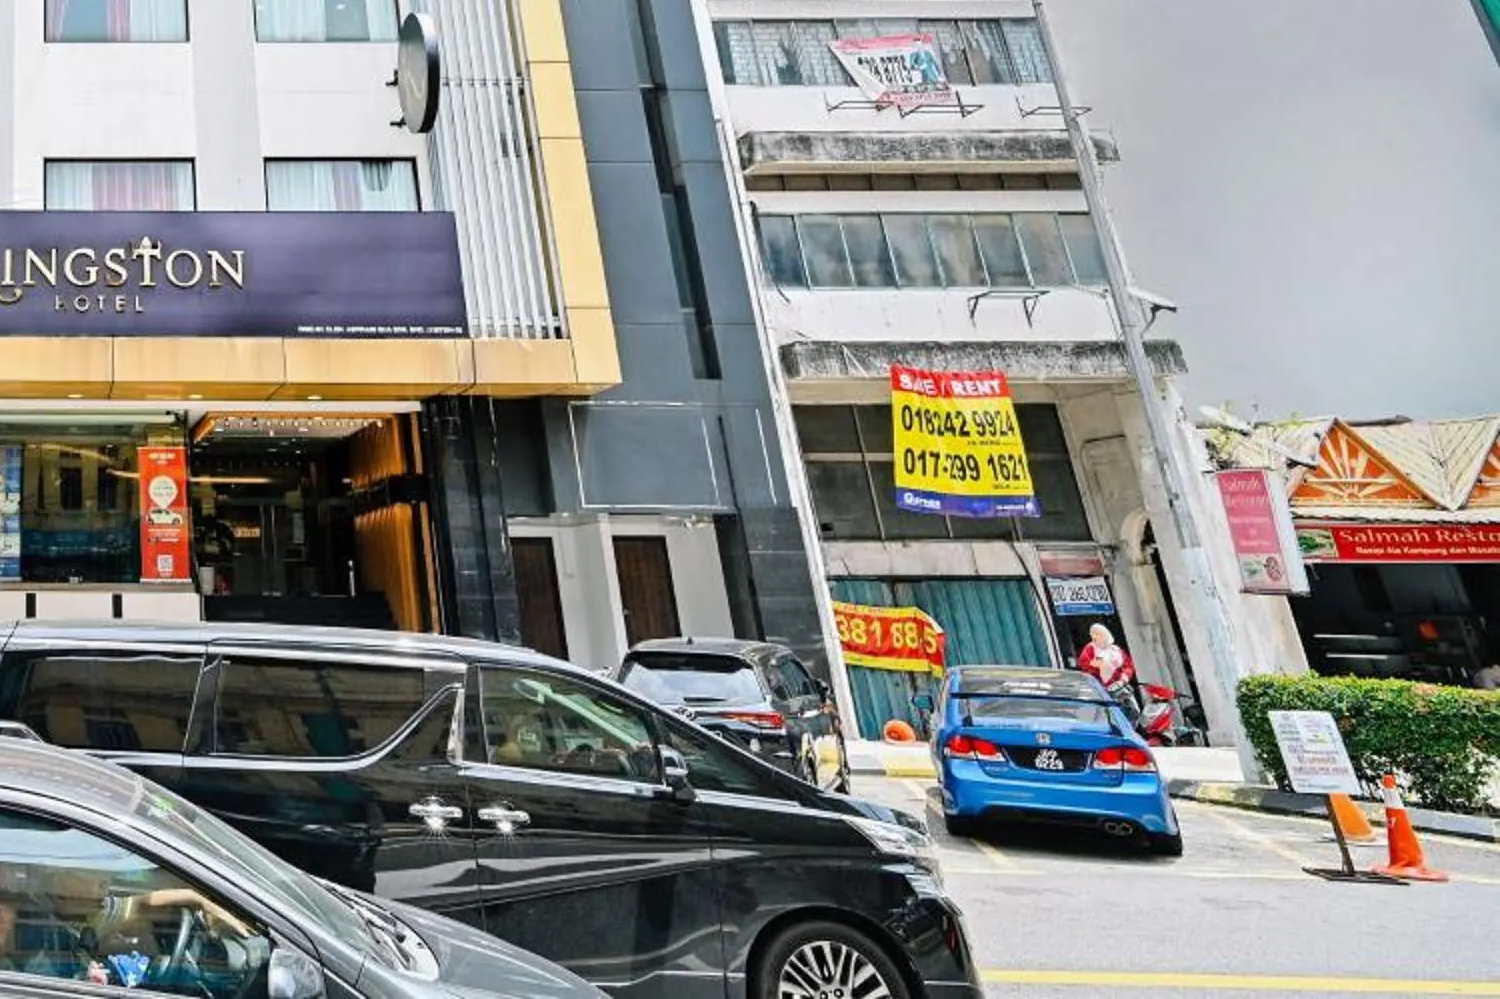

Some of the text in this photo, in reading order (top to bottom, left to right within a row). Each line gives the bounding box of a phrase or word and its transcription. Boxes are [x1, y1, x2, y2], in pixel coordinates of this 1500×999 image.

[55, 295, 145, 313] HOTEL
[950, 380, 1001, 395] RENT
[987, 453, 1028, 481] 1621
[1339, 528, 1430, 543] Salmah
